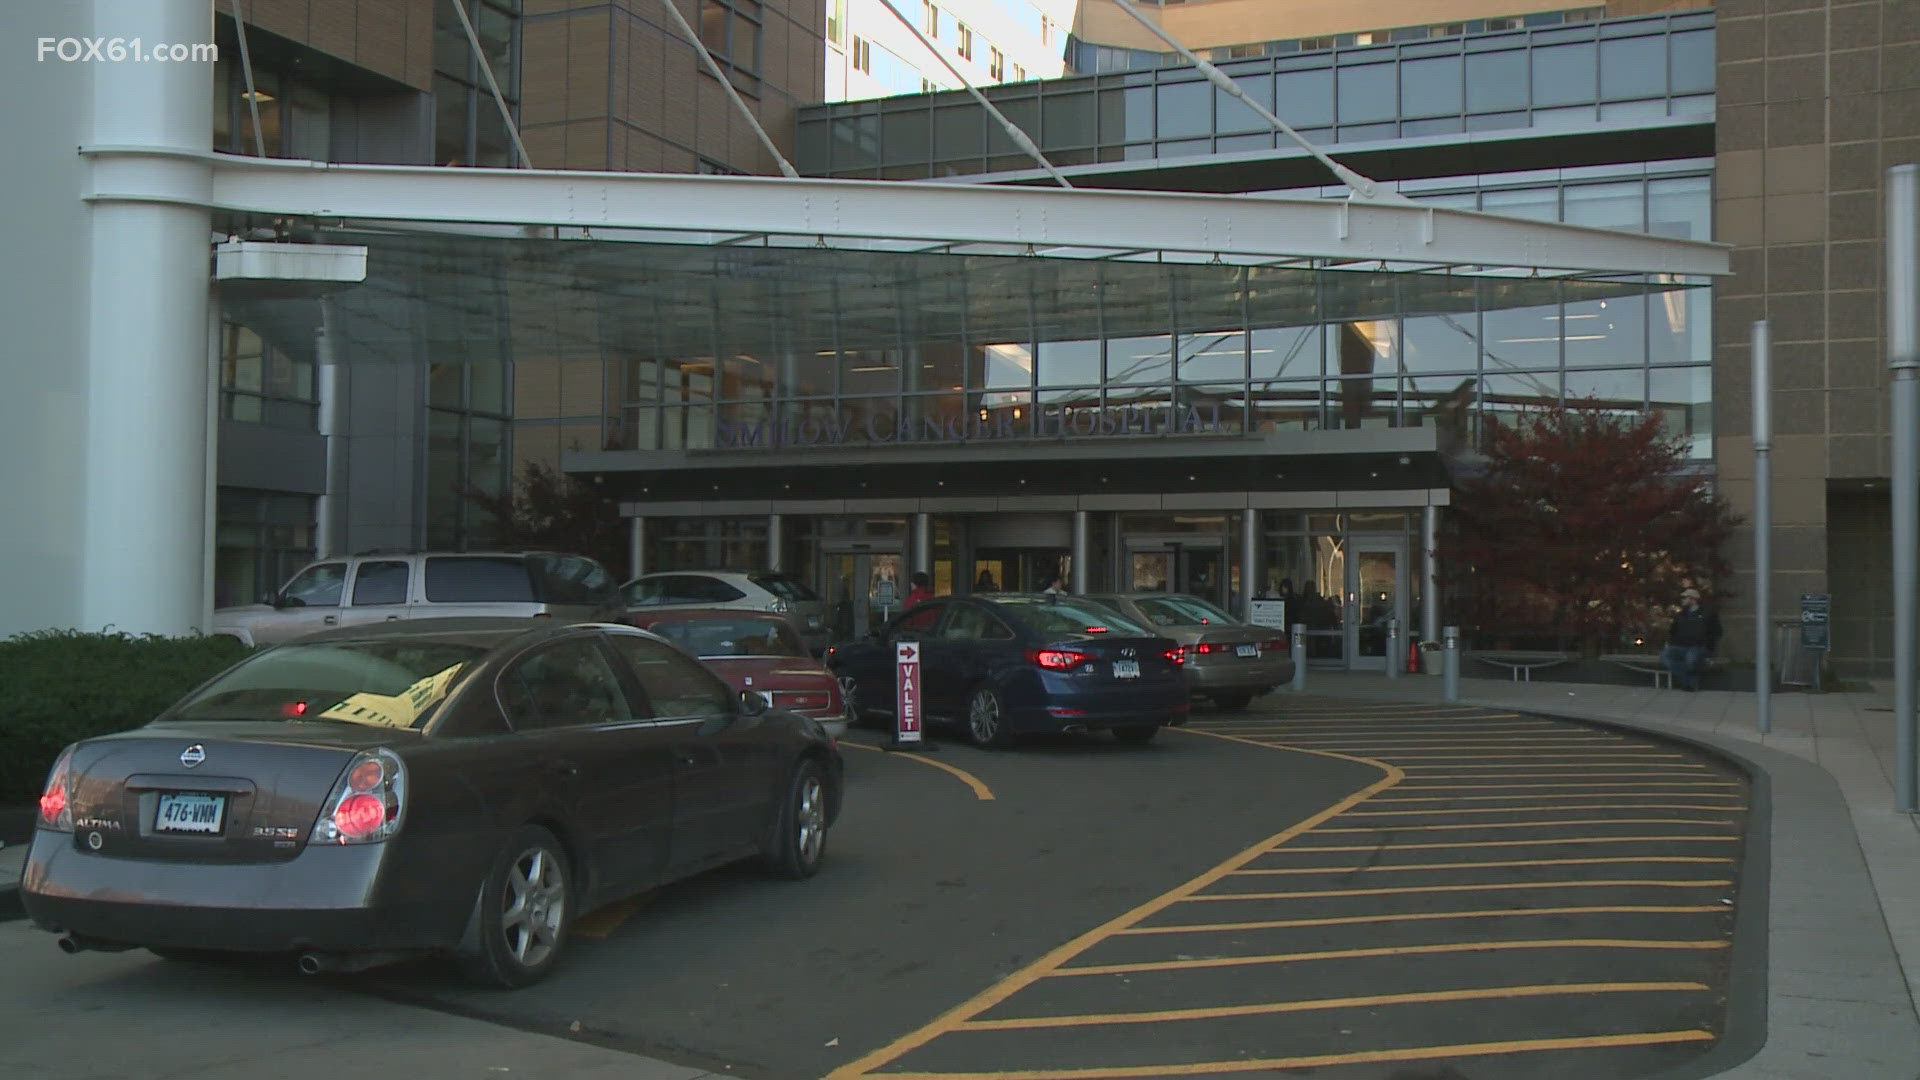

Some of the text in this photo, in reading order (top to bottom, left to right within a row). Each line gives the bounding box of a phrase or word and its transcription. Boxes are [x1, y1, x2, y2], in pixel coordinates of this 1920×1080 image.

[717, 400, 1230, 449] SMILOW CANCER HOSPITAL
[903, 665, 914, 730] VALET
[76, 818, 121, 830] ALTIMA
